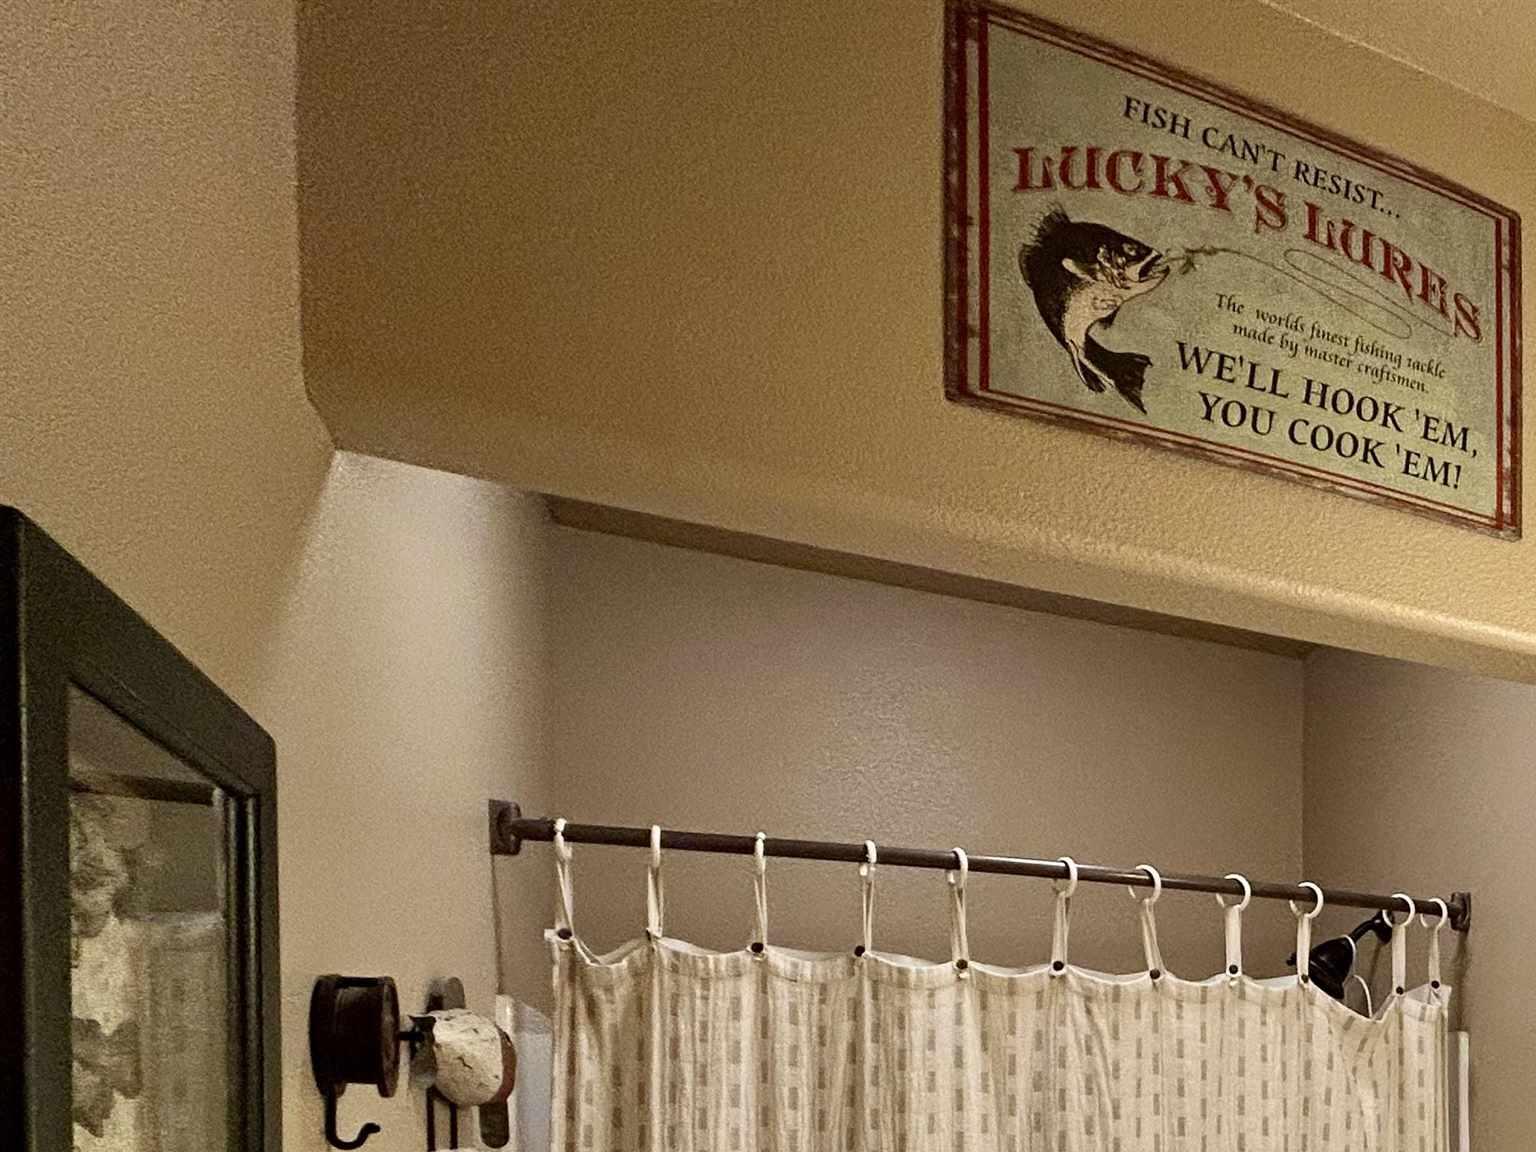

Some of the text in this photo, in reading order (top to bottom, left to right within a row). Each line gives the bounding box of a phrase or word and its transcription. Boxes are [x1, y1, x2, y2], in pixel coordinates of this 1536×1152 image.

[1124, 95, 1192, 139] FISH
[1201, 126, 1287, 173] CAN'T
[1012, 145, 1483, 343] LUCKY'S LURES
[1215, 293, 1446, 380] The worlds finest fishing tackle
[1232, 322, 1275, 346] made
[1279, 334, 1300, 358] by
[1304, 340, 1353, 369] master
[1175, 341, 1290, 399] WE'LL
[1302, 376, 1404, 433] HOOK
[1199, 391, 1463, 490] YOU COOK 'EM!
